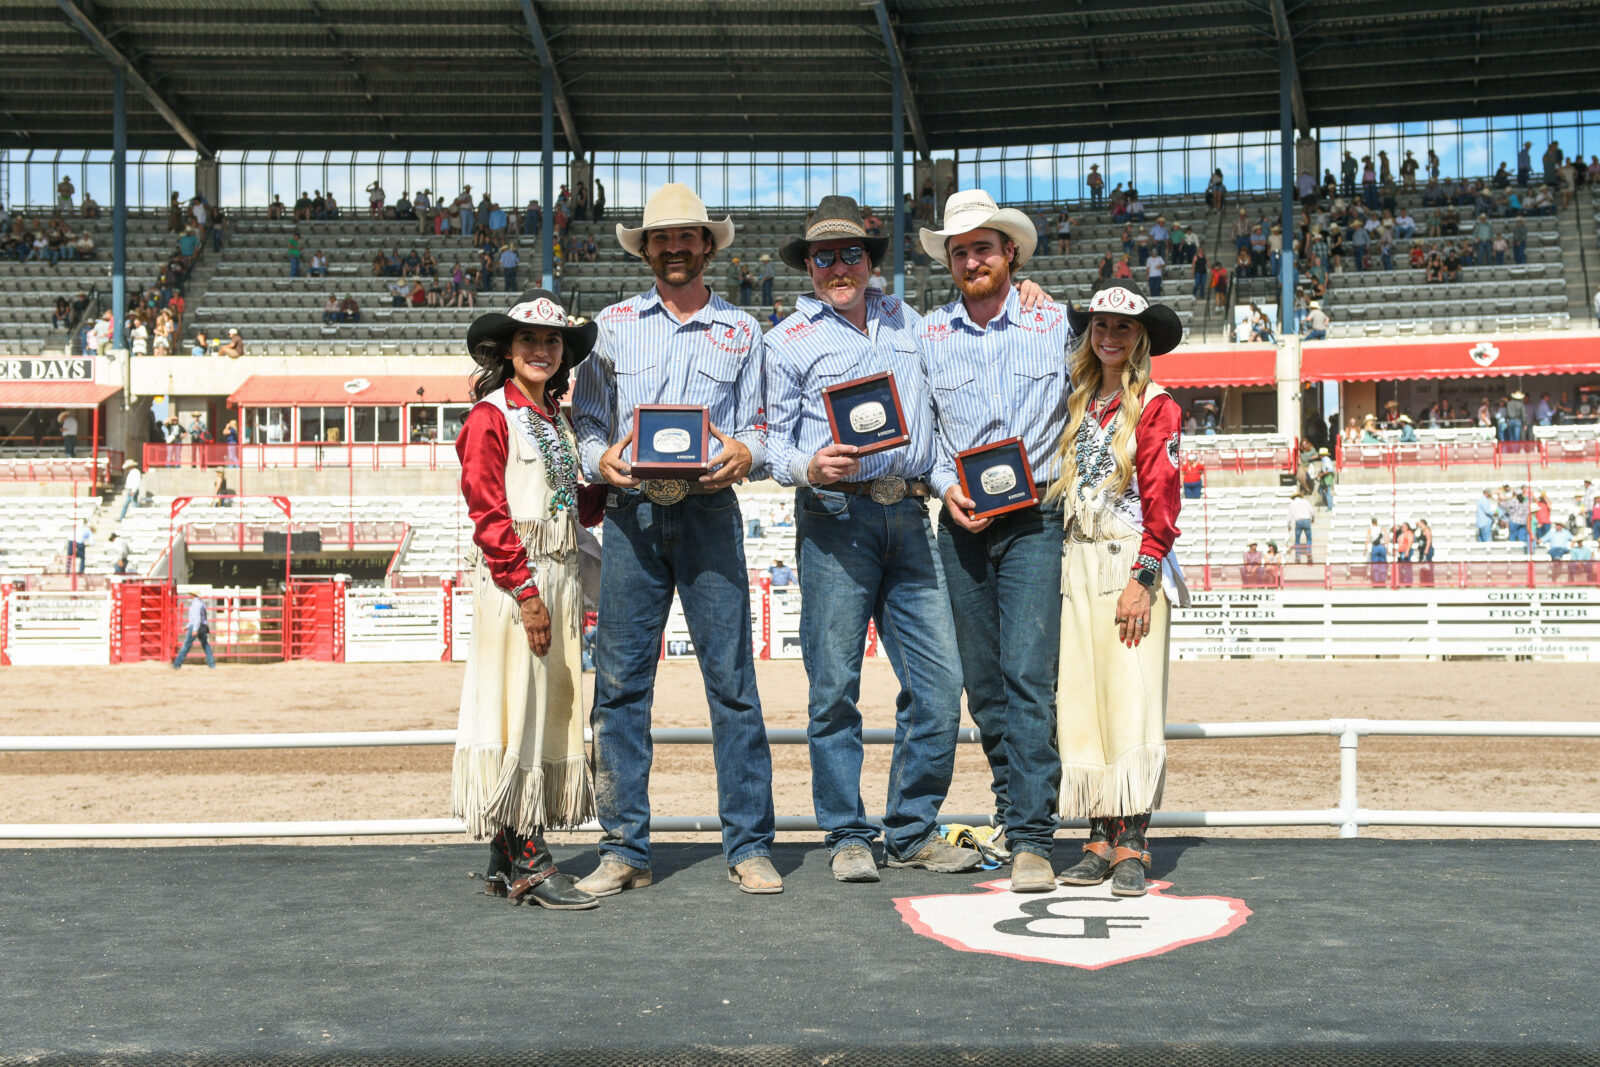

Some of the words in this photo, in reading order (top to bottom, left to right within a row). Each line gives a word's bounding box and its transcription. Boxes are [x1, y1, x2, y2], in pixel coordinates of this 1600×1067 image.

[610, 305, 634, 313] FMK
[1034, 312, 1044, 322] &
[785, 321, 804, 336] FMK
[927, 324, 948, 333] FMK
[725, 328, 735, 339] &
[30, 360, 86, 379] DAYS
[1191, 594, 1276, 602] HEYENNE
[1487, 592, 1589, 600] CHEYENNE
[1181, 610, 1276, 618] FRONTIER
[1488, 609, 1589, 617] FRONTIER
[1204, 627, 1250, 635] DAYS
[1514, 626, 1562, 635] DAYS
